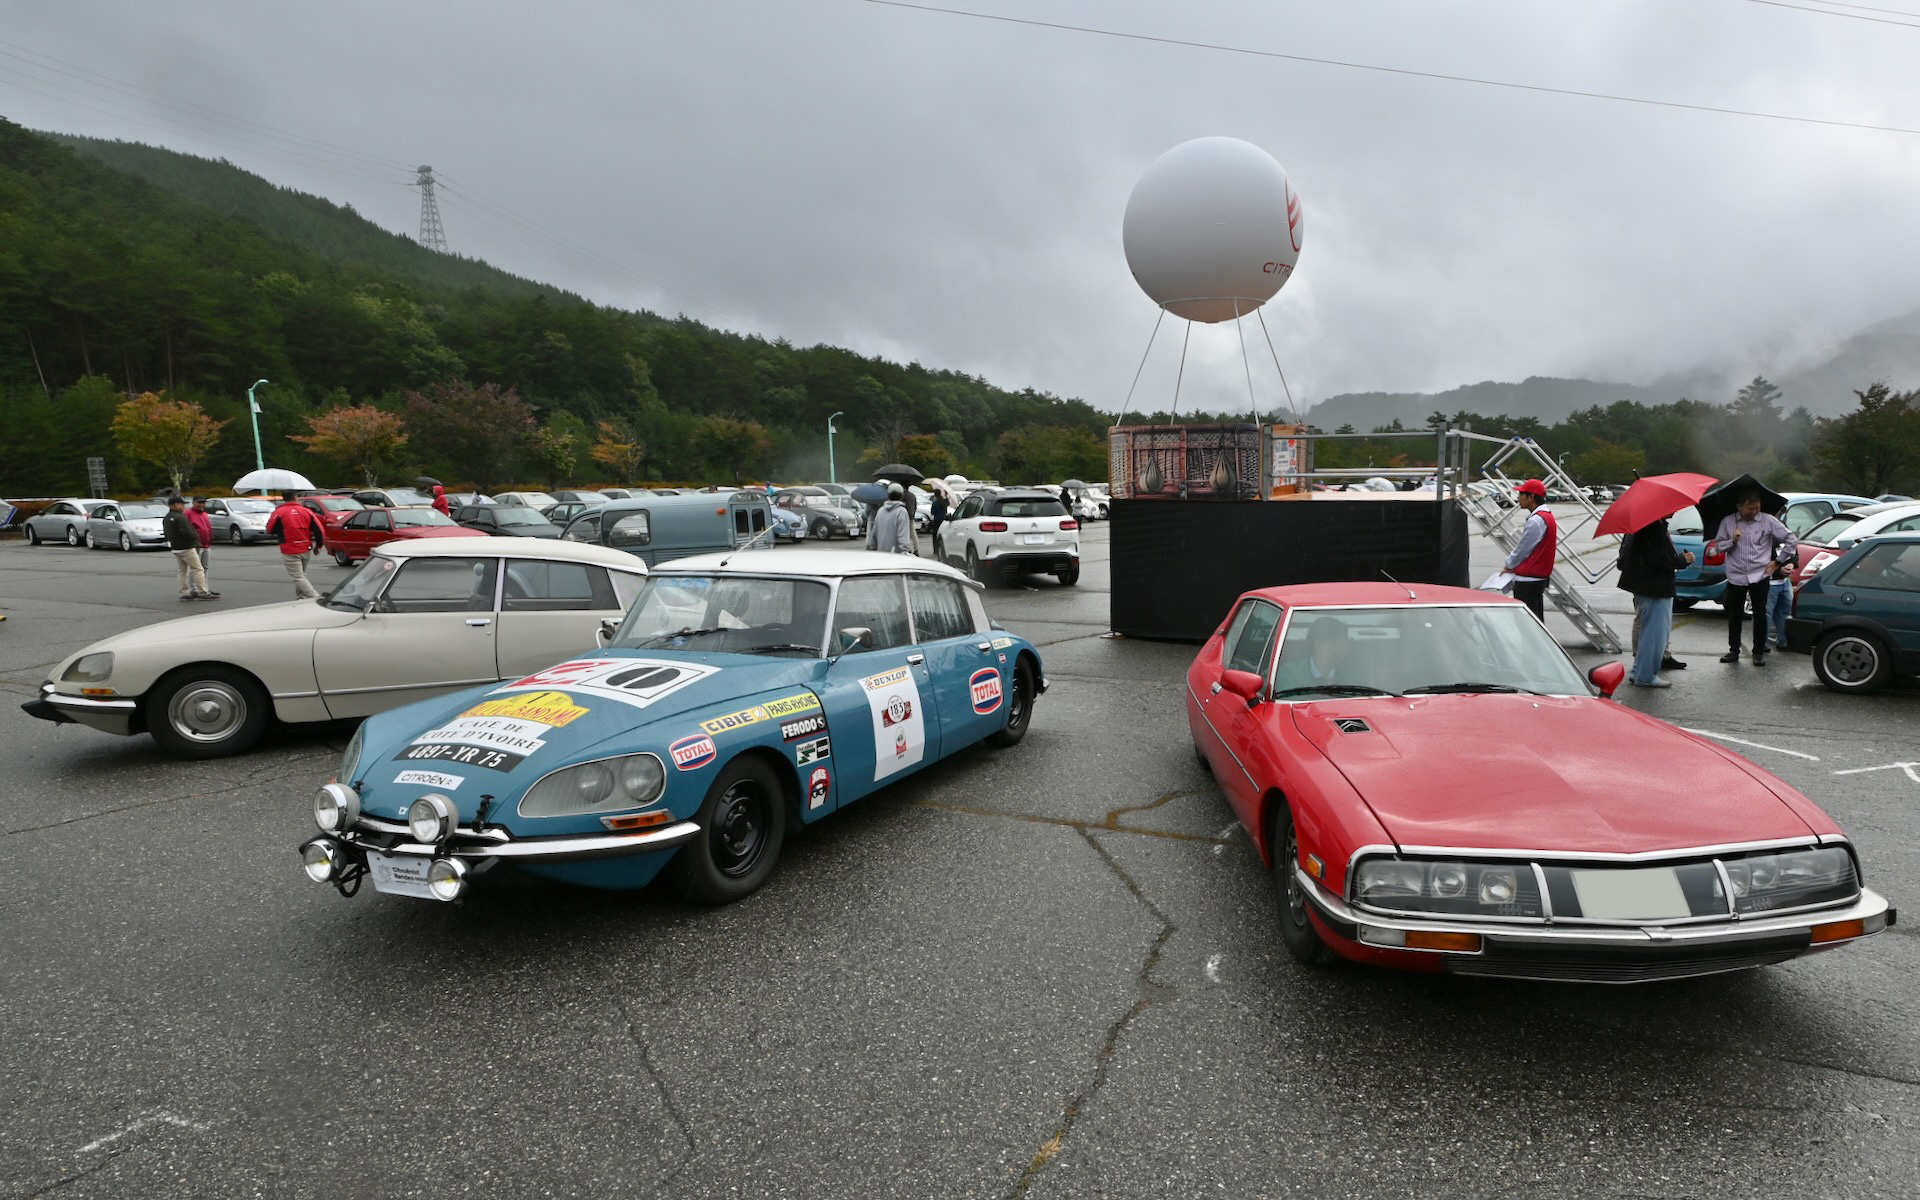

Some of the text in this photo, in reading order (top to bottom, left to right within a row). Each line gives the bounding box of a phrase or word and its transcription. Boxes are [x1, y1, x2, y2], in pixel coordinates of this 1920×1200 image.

[873, 670, 907, 686] DUNLOP
[974, 681, 999, 701] TOTAL
[767, 701, 793, 715] PARIS
[503, 723, 529, 734] DE
[781, 718, 818, 738] FERODO
[463, 730, 540, 750] D'IVOIRE
[478, 751, 508, 768] 75
[676, 742, 711, 762] TOTAL
